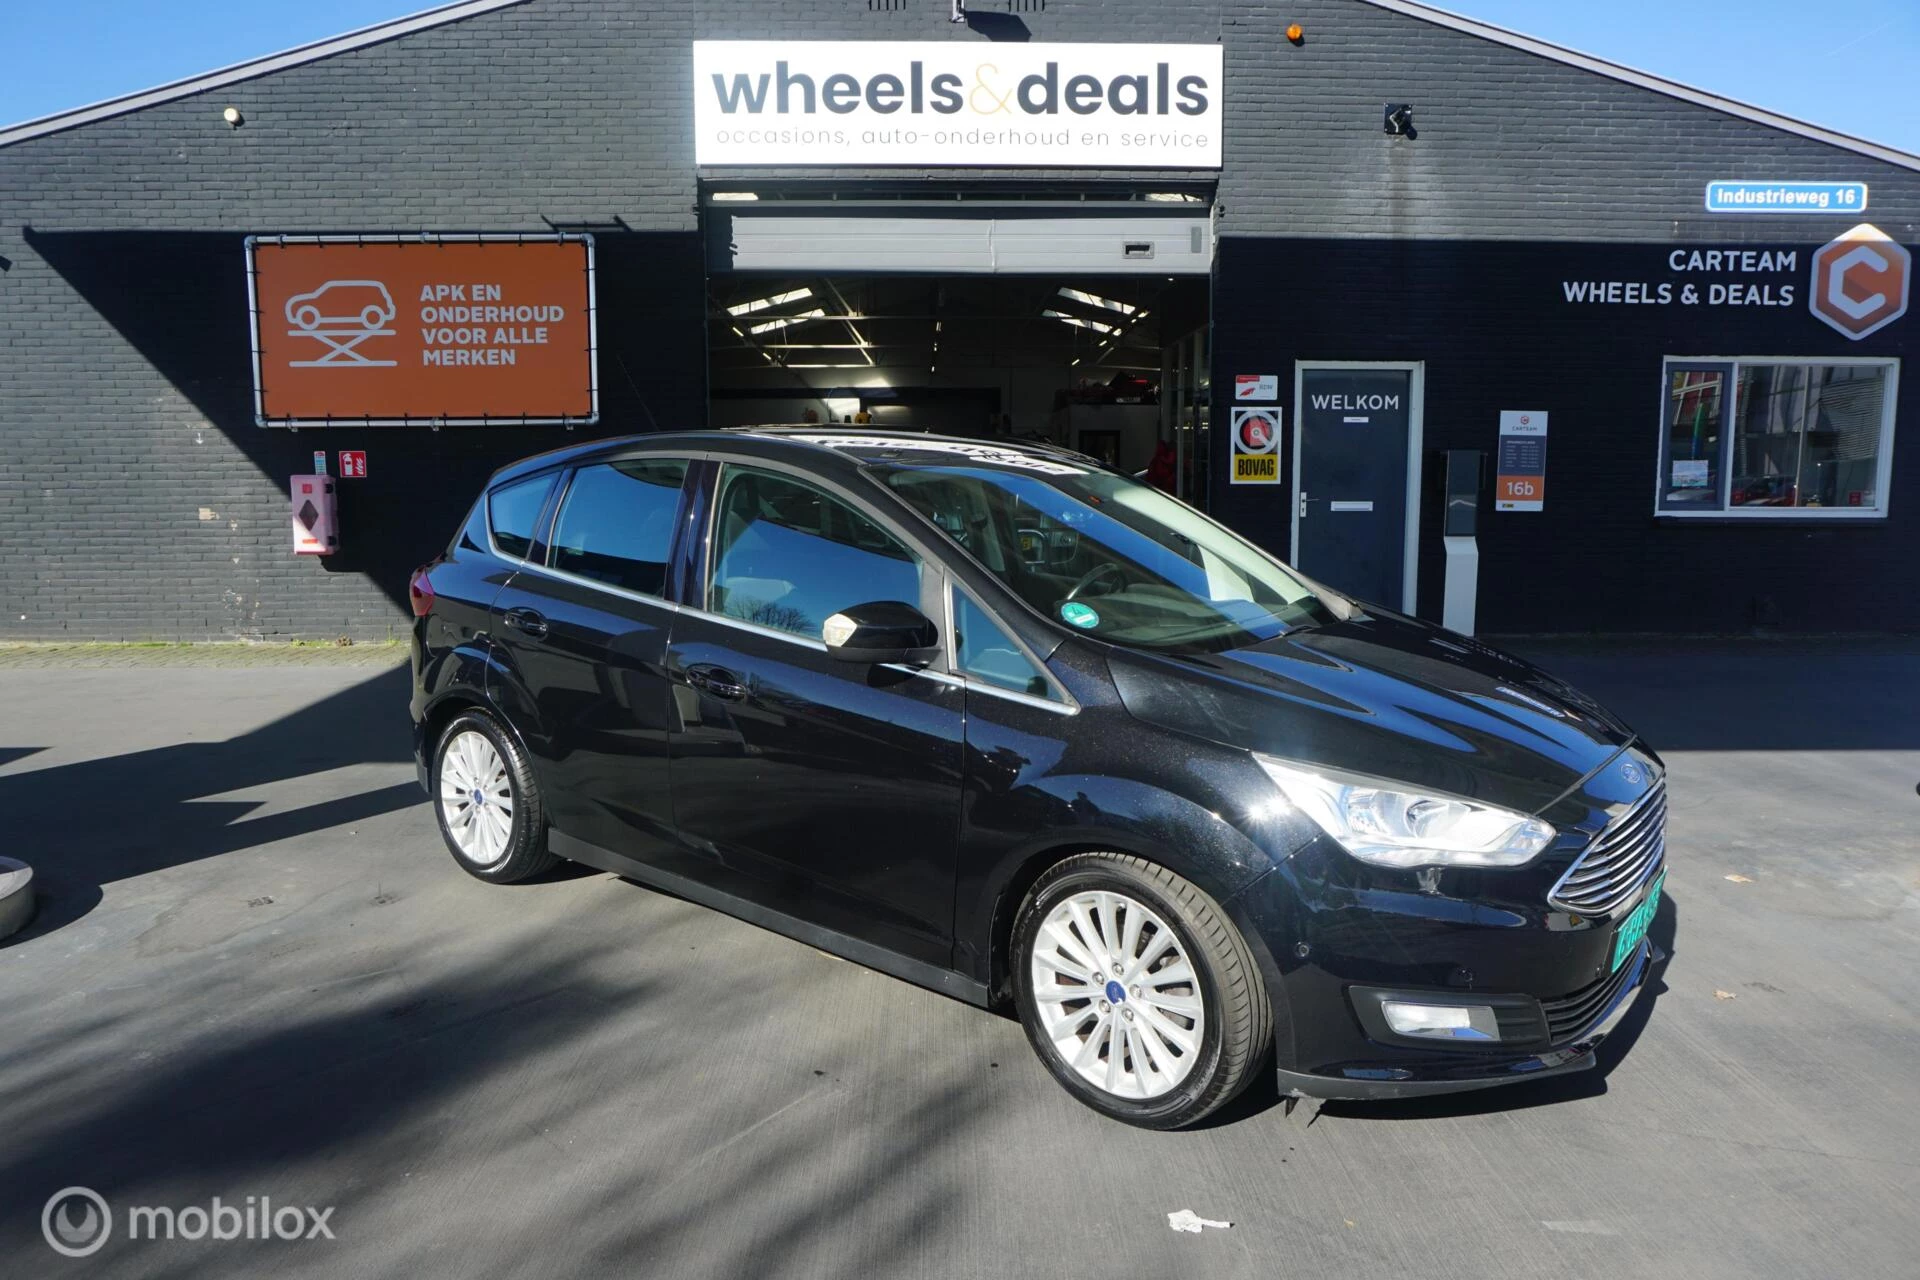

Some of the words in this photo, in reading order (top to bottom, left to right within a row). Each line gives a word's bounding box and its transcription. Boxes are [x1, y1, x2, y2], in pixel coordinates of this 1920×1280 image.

[716, 126, 851, 147] occasions,
[861, 127, 1070, 146] auto-onderhoud
[1081, 131, 1110, 146] en
[1121, 129, 1208, 148] service
[1717, 188, 1829, 207] Industrieweg
[1835, 189, 1855, 204] 16
[1669, 250, 1796, 272] CARTEAM
[420, 284, 466, 301] APK
[472, 285, 500, 300] EN
[1563, 281, 1672, 304] WHEELS
[1680, 284, 1699, 304] &
[1709, 284, 1794, 306] DEALS
[421, 305, 564, 322] ONDERHOUD
[422, 328, 487, 344] VOOR
[493, 328, 548, 343] ALLE
[423, 349, 515, 365] MERKEN
[1312, 395, 1399, 410] WELKOM
[1238, 459, 1274, 476] BOVAG
[1507, 481, 1534, 496] 16b
